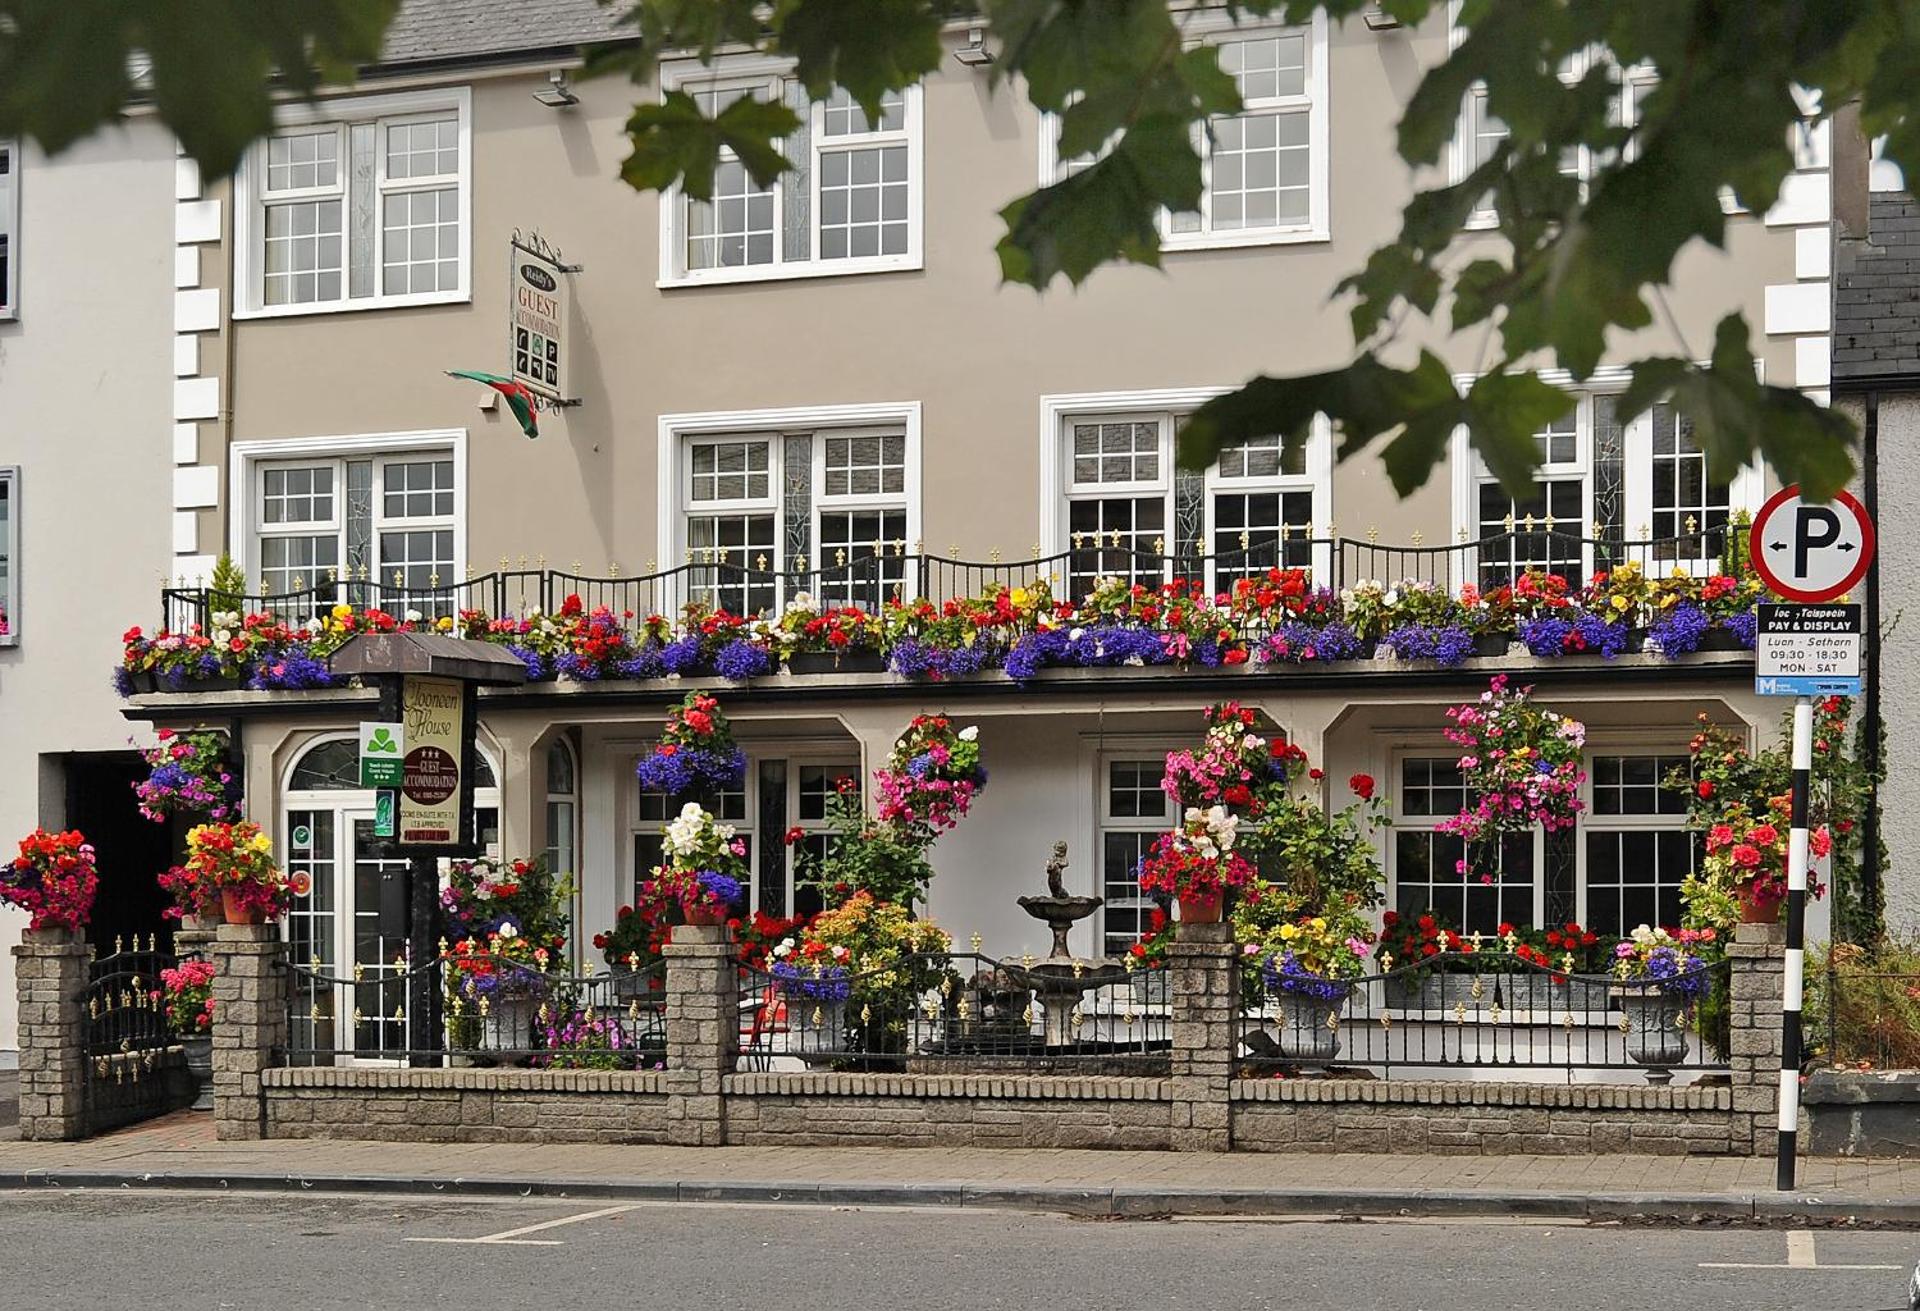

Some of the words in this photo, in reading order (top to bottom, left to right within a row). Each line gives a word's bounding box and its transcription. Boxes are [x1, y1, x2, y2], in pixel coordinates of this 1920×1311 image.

[518, 286, 559, 320] GUEST
[1794, 506, 1842, 578] P
[1768, 621, 1790, 631] PAY
[1792, 621, 1801, 631] &
[1803, 621, 1852, 631] DISPLAY
[1767, 637, 1794, 647] Luan
[1807, 637, 1852, 647] Satharn
[1780, 663, 1806, 673] MON
[1816, 663, 1838, 673] SAT
[404, 707, 452, 742] House
[420, 760, 441, 774] GUEST
